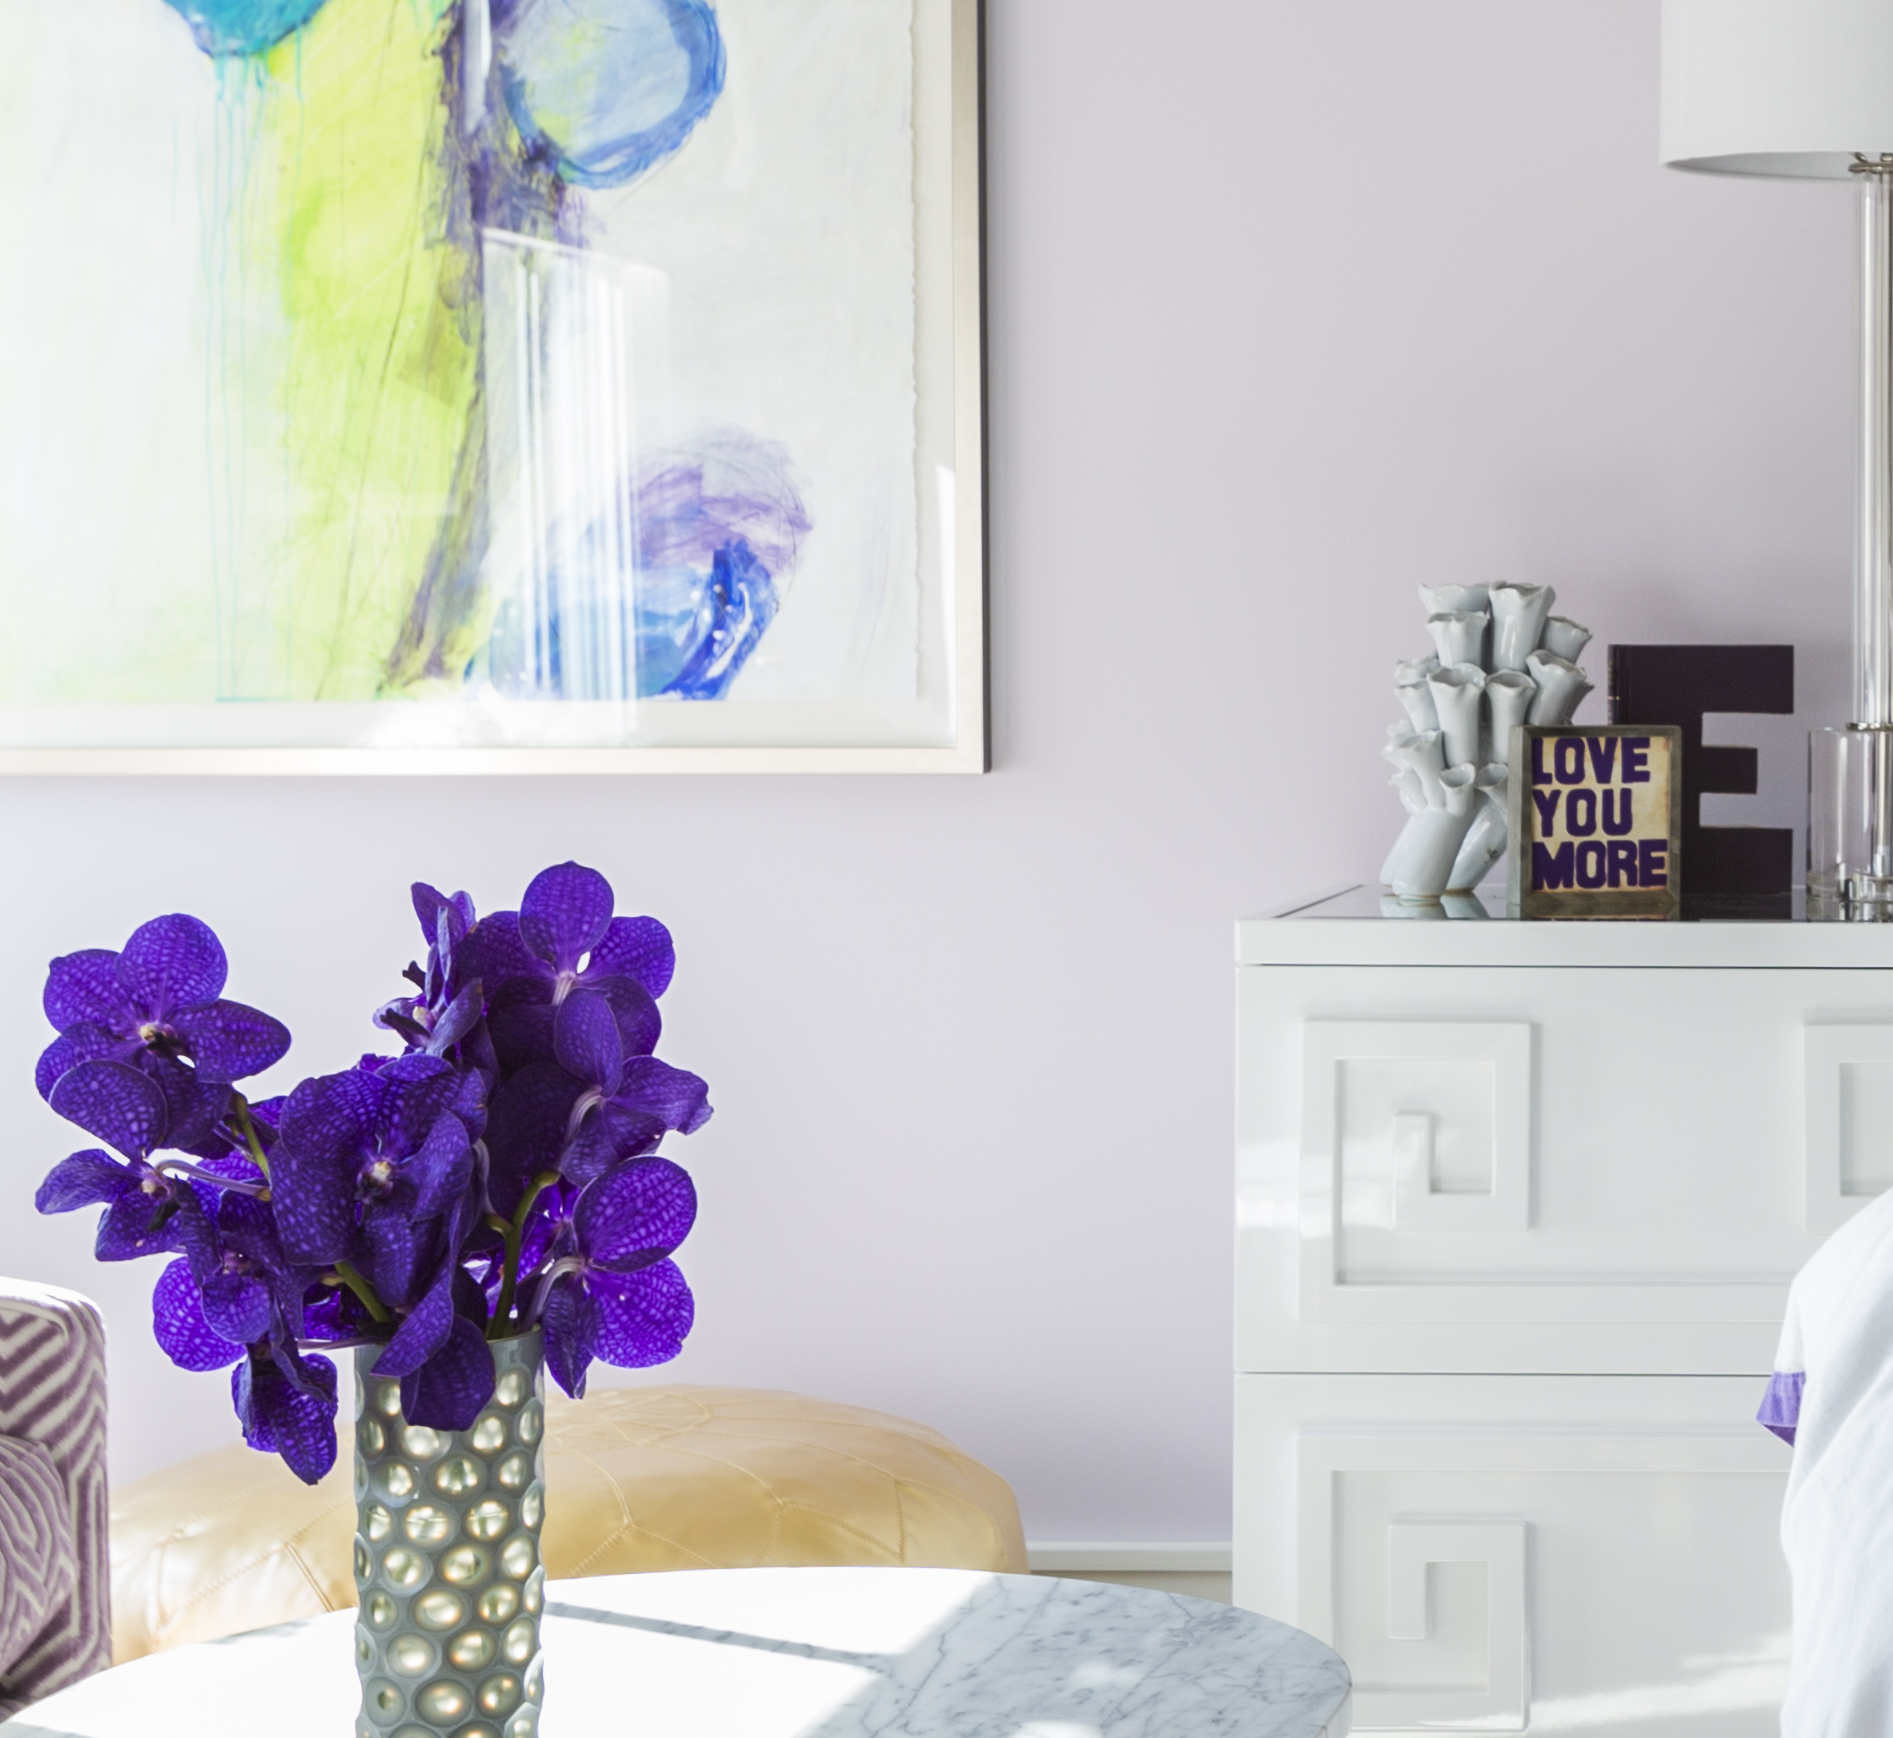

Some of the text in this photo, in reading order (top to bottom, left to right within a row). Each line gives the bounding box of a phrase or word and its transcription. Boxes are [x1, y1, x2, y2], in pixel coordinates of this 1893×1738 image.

[1531, 736, 1651, 785] LOVE
[1608, 644, 1794, 895] E
[1532, 787, 1633, 838] YOU
[1531, 839, 1668, 890] MORE
